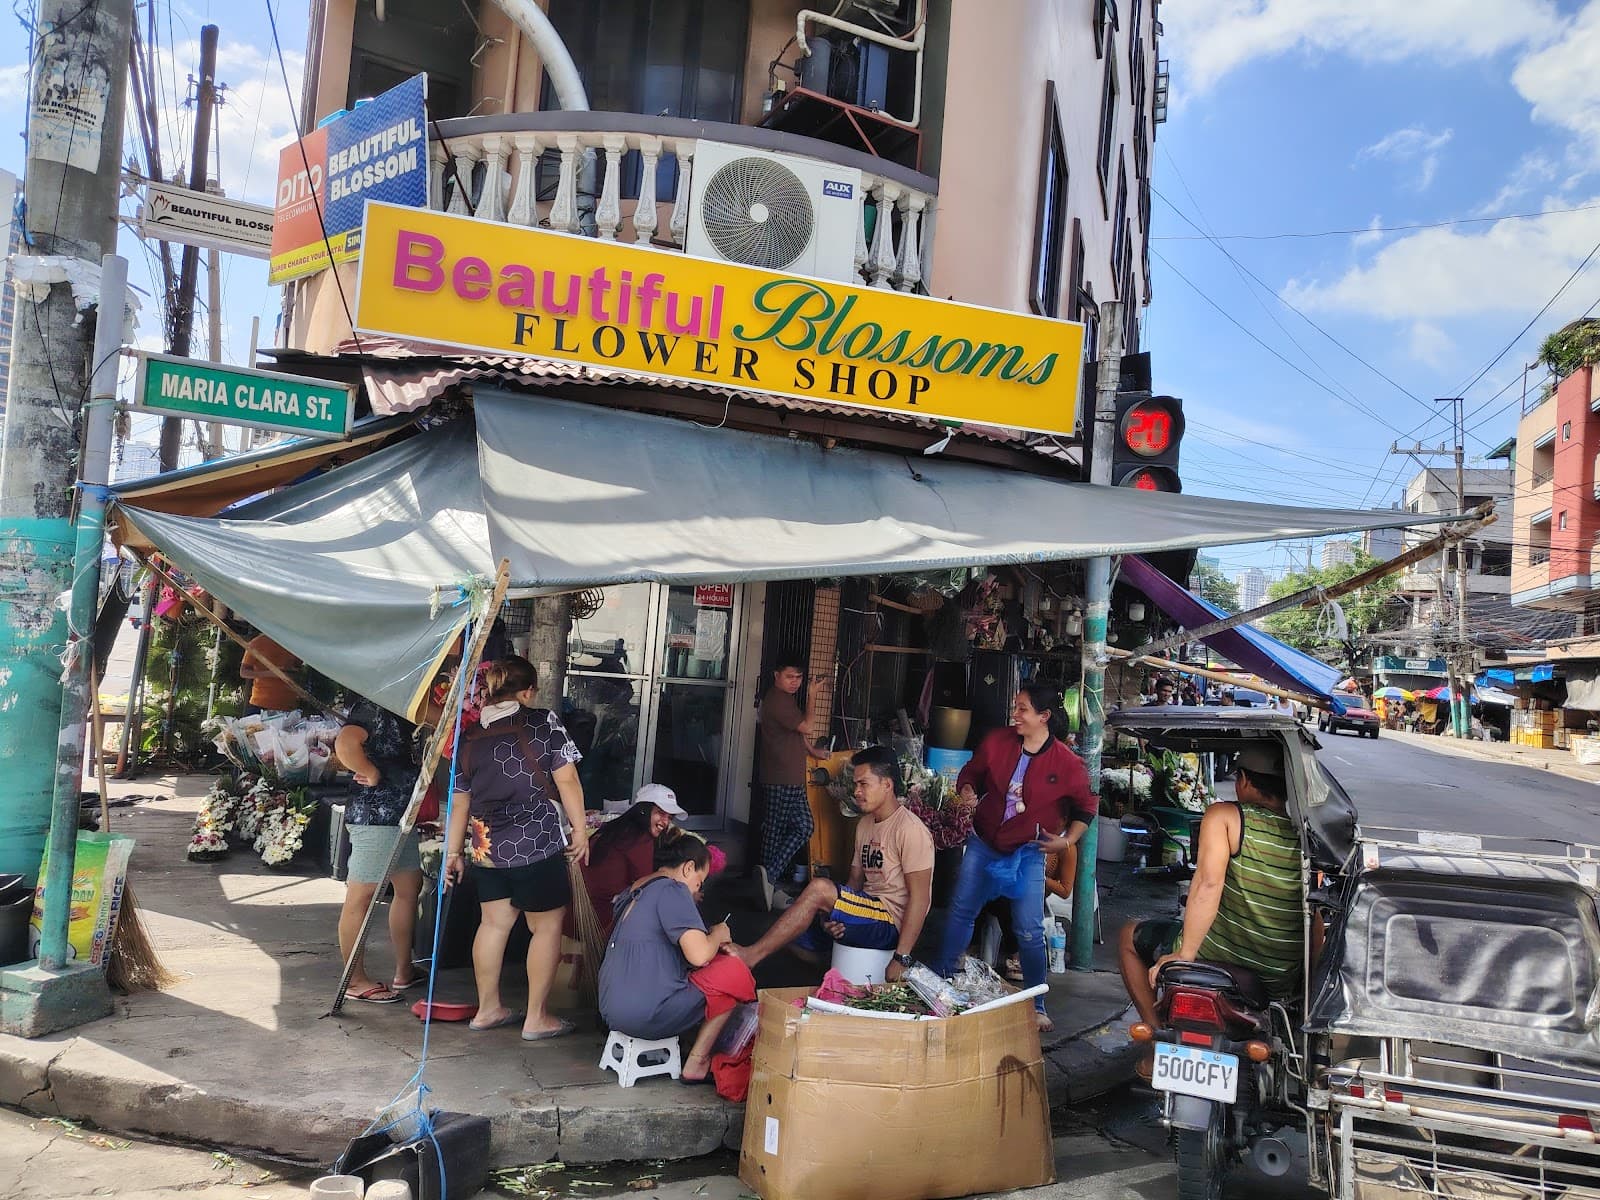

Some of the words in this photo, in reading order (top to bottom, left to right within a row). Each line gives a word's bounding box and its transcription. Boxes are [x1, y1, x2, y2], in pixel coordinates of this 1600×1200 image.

[329, 117, 422, 177] BEAUTIFUL
[278, 163, 322, 208] DITO
[331, 147, 417, 202] BLOSSOM
[825, 182, 851, 193] AUX
[171, 203, 232, 224] BEAUTIFUL
[287, 255, 310, 269] CHARGE
[310, 250, 326, 262] YOUR
[393, 230, 725, 340] Beautiful
[733, 279, 1058, 385] Blossoms
[512, 312, 760, 381] FLOWER
[793, 358, 932, 405] SHOP
[161, 372, 229, 406] MARIA
[234, 384, 300, 416] CLARA
[305, 395, 333, 421] ST.
[1126, 409, 1170, 449] 20
[699, 584, 729, 593] OPEN
[111, 877, 124, 911] RICE
[1157, 1054, 1233, 1090] 500CFY
